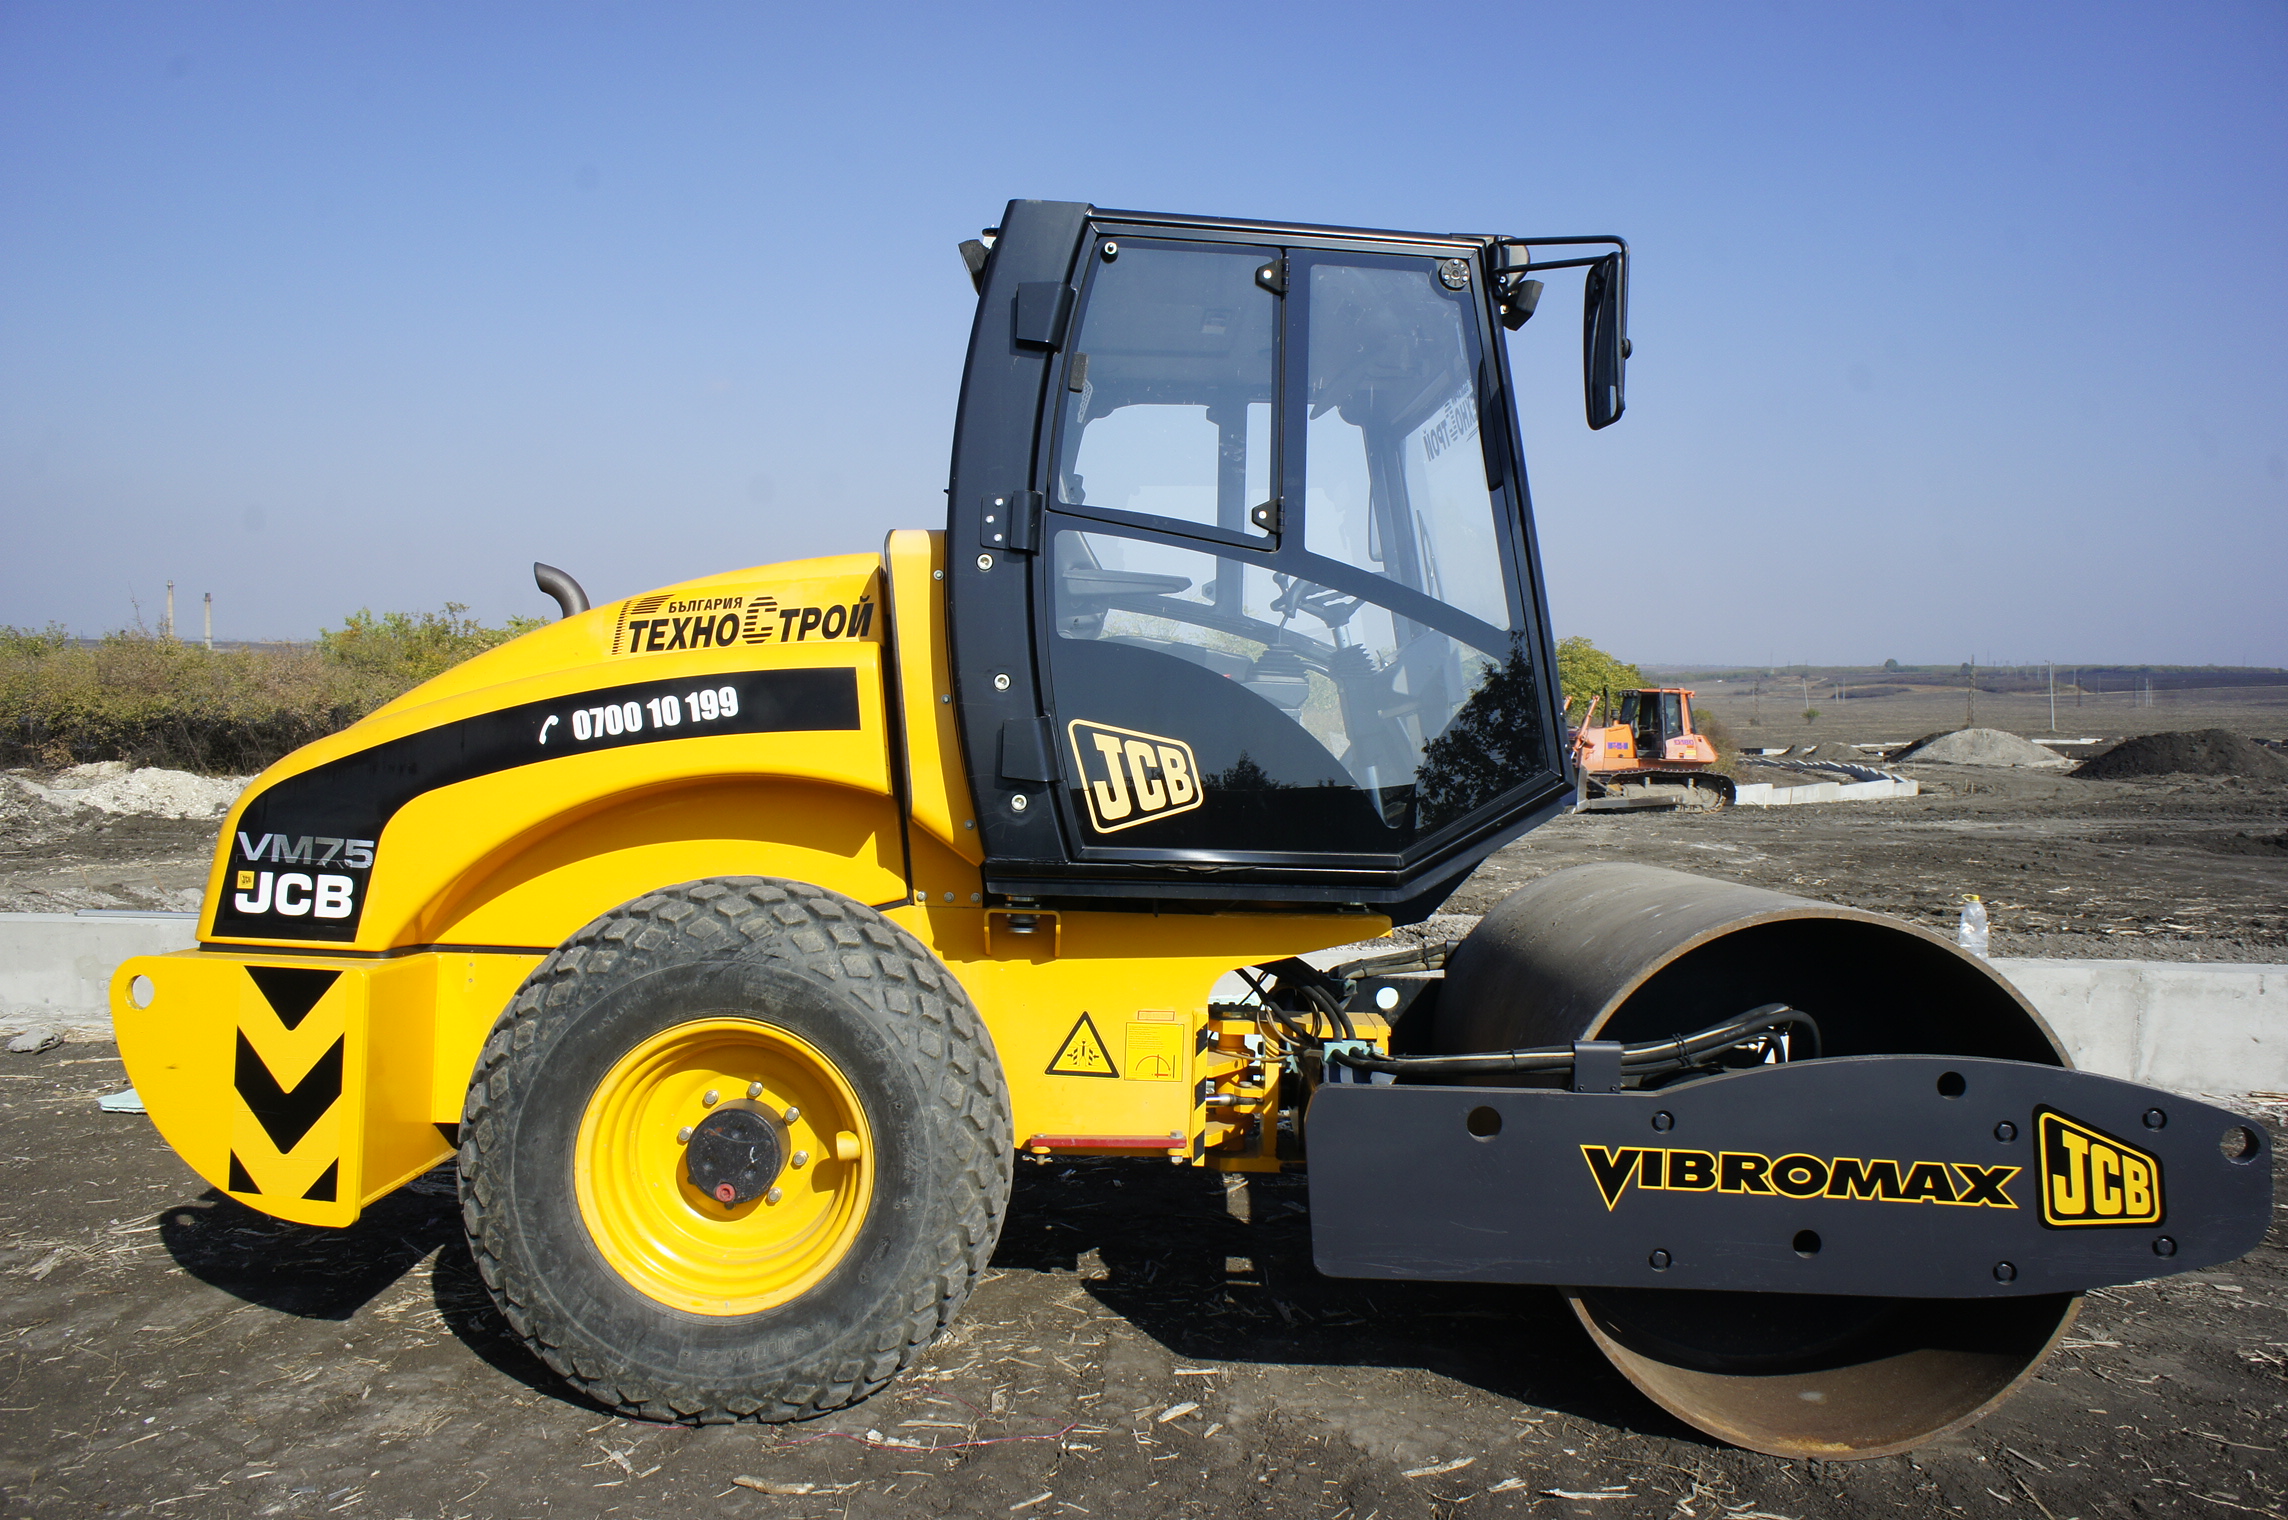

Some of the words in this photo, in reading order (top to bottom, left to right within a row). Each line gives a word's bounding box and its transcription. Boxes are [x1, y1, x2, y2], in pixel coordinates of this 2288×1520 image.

[668, 596, 743, 614] БЪЛГАРИЯ
[571, 699, 643, 741] 0700
[646, 694, 682, 729] 10
[685, 686, 739, 723] 199
[1092, 732, 1194, 821] JCB
[237, 831, 375, 870] VM75
[234, 871, 354, 919] JCB
[1579, 1143, 2023, 1212] VIBROMAX
[2052, 1129, 2151, 1217] JCB
